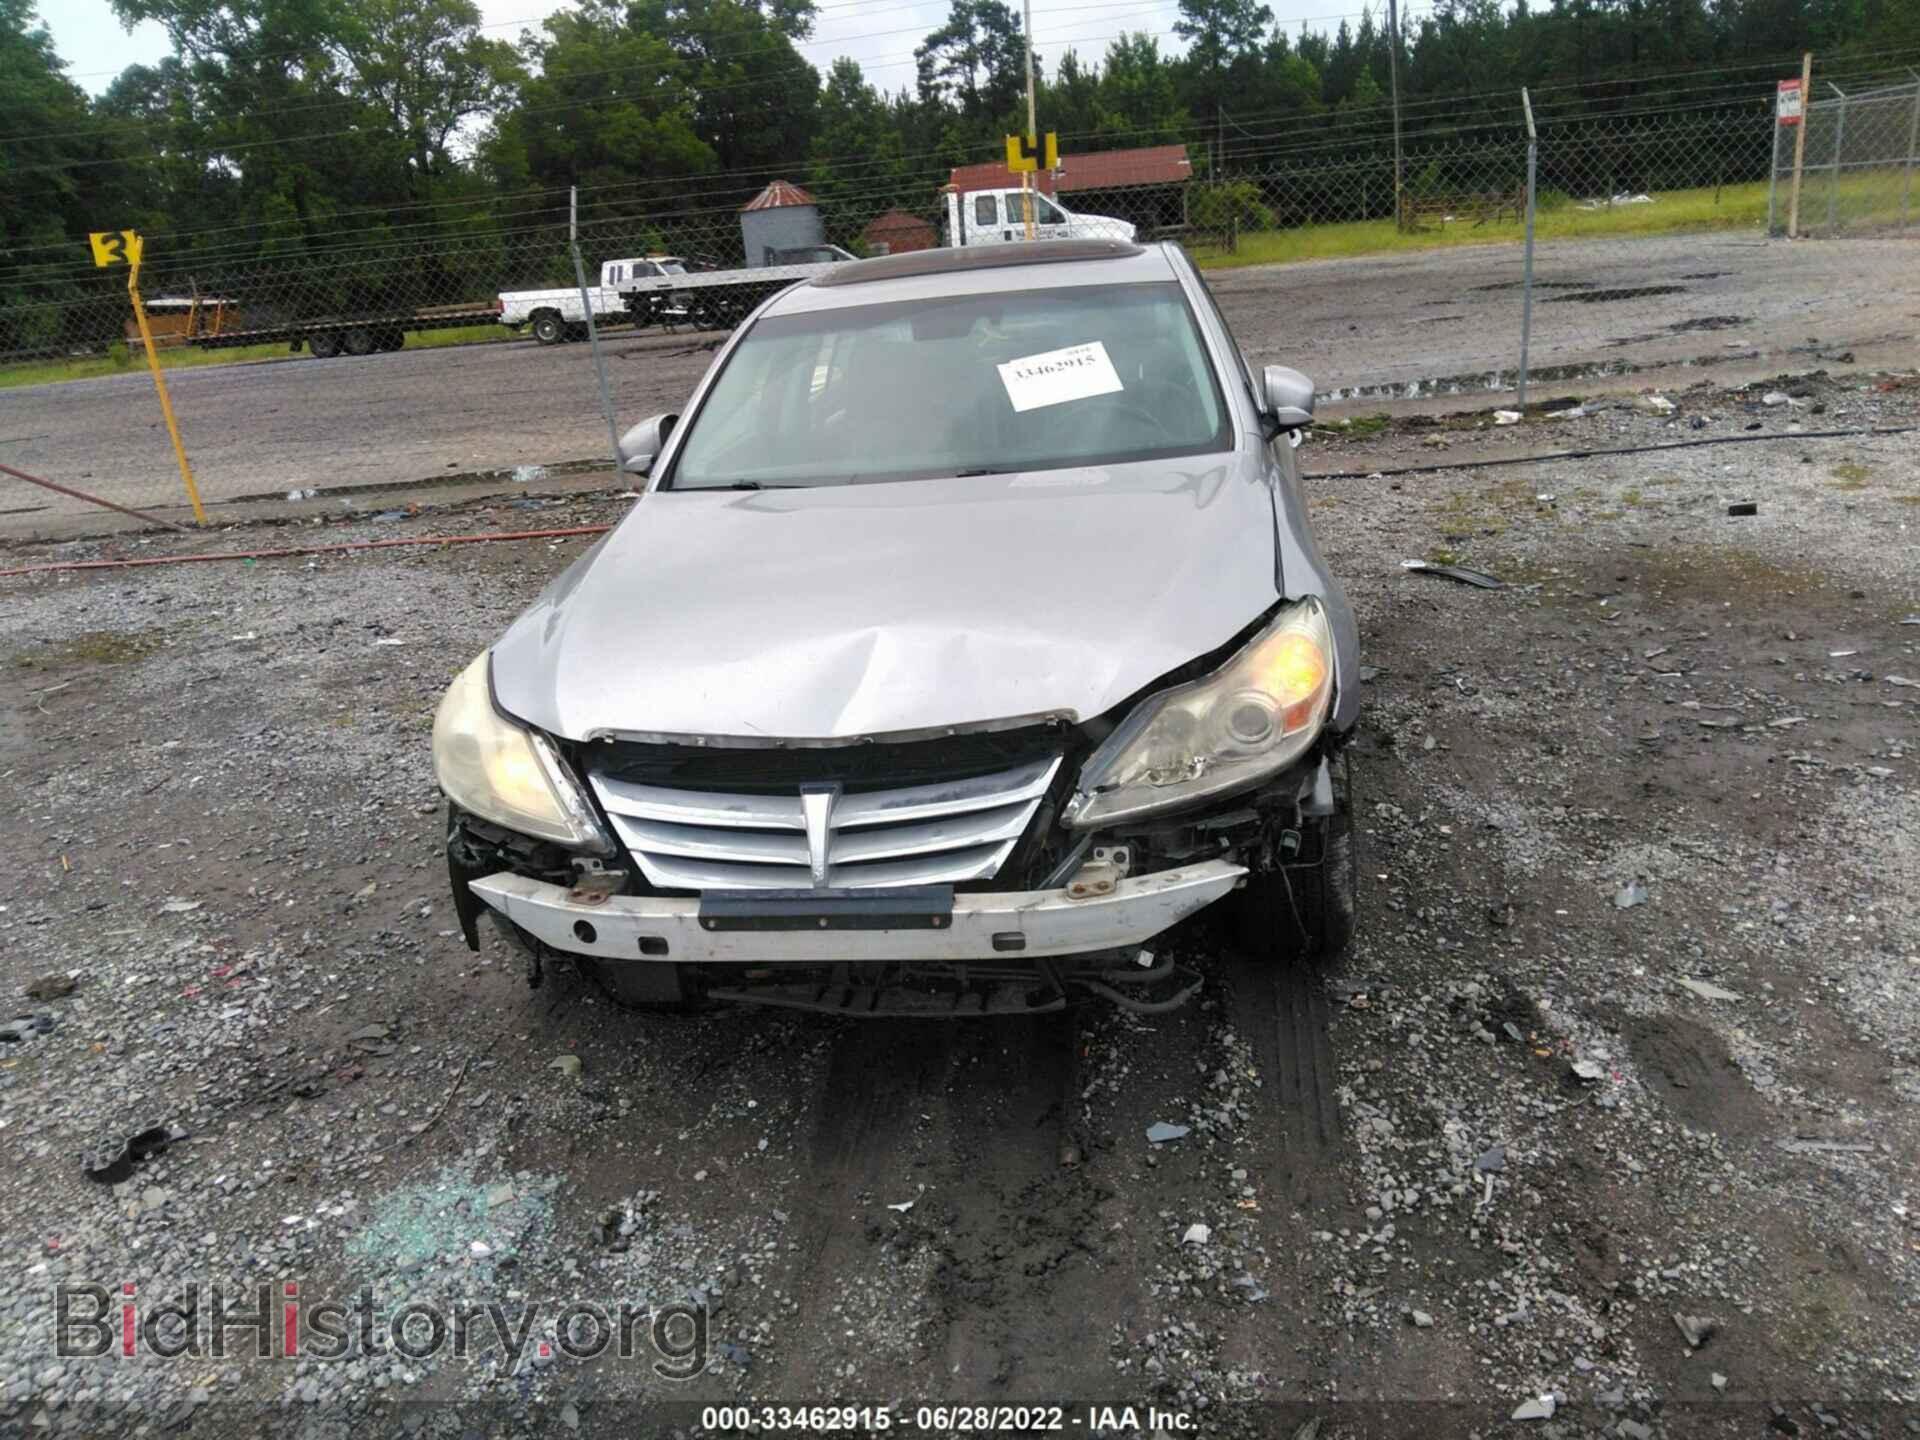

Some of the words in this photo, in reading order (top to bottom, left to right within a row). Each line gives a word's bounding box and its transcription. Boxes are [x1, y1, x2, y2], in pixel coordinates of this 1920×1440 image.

[1020, 133, 1047, 170] 4
[101, 232, 128, 265] 3
[1014, 354, 1097, 382] 33462915
